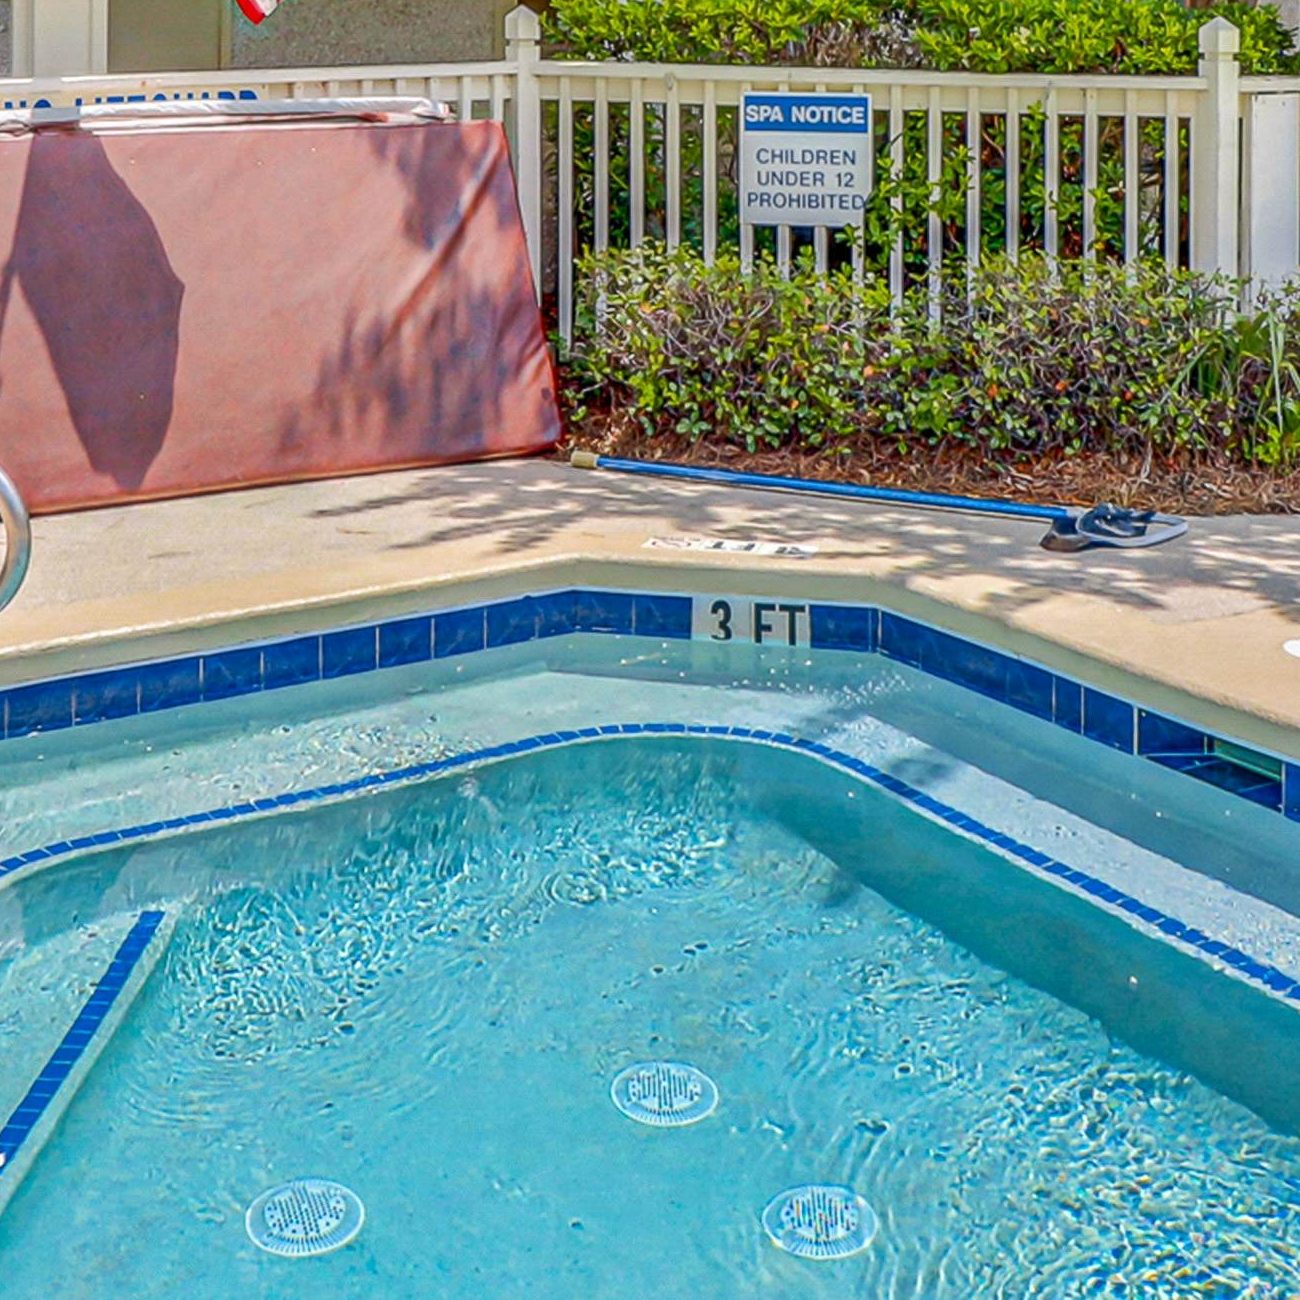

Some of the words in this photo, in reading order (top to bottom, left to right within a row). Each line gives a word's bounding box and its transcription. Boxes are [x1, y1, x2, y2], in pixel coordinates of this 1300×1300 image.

[746, 105, 784, 123] SPA
[791, 105, 865, 124] NOTICE
[756, 148, 856, 166] CHILDREN
[757, 171, 825, 187] UNDER
[836, 173, 855, 188] 12
[748, 192, 865, 210] PROHIBITED
[710, 599, 733, 641] 3
[753, 603, 806, 646] FT
